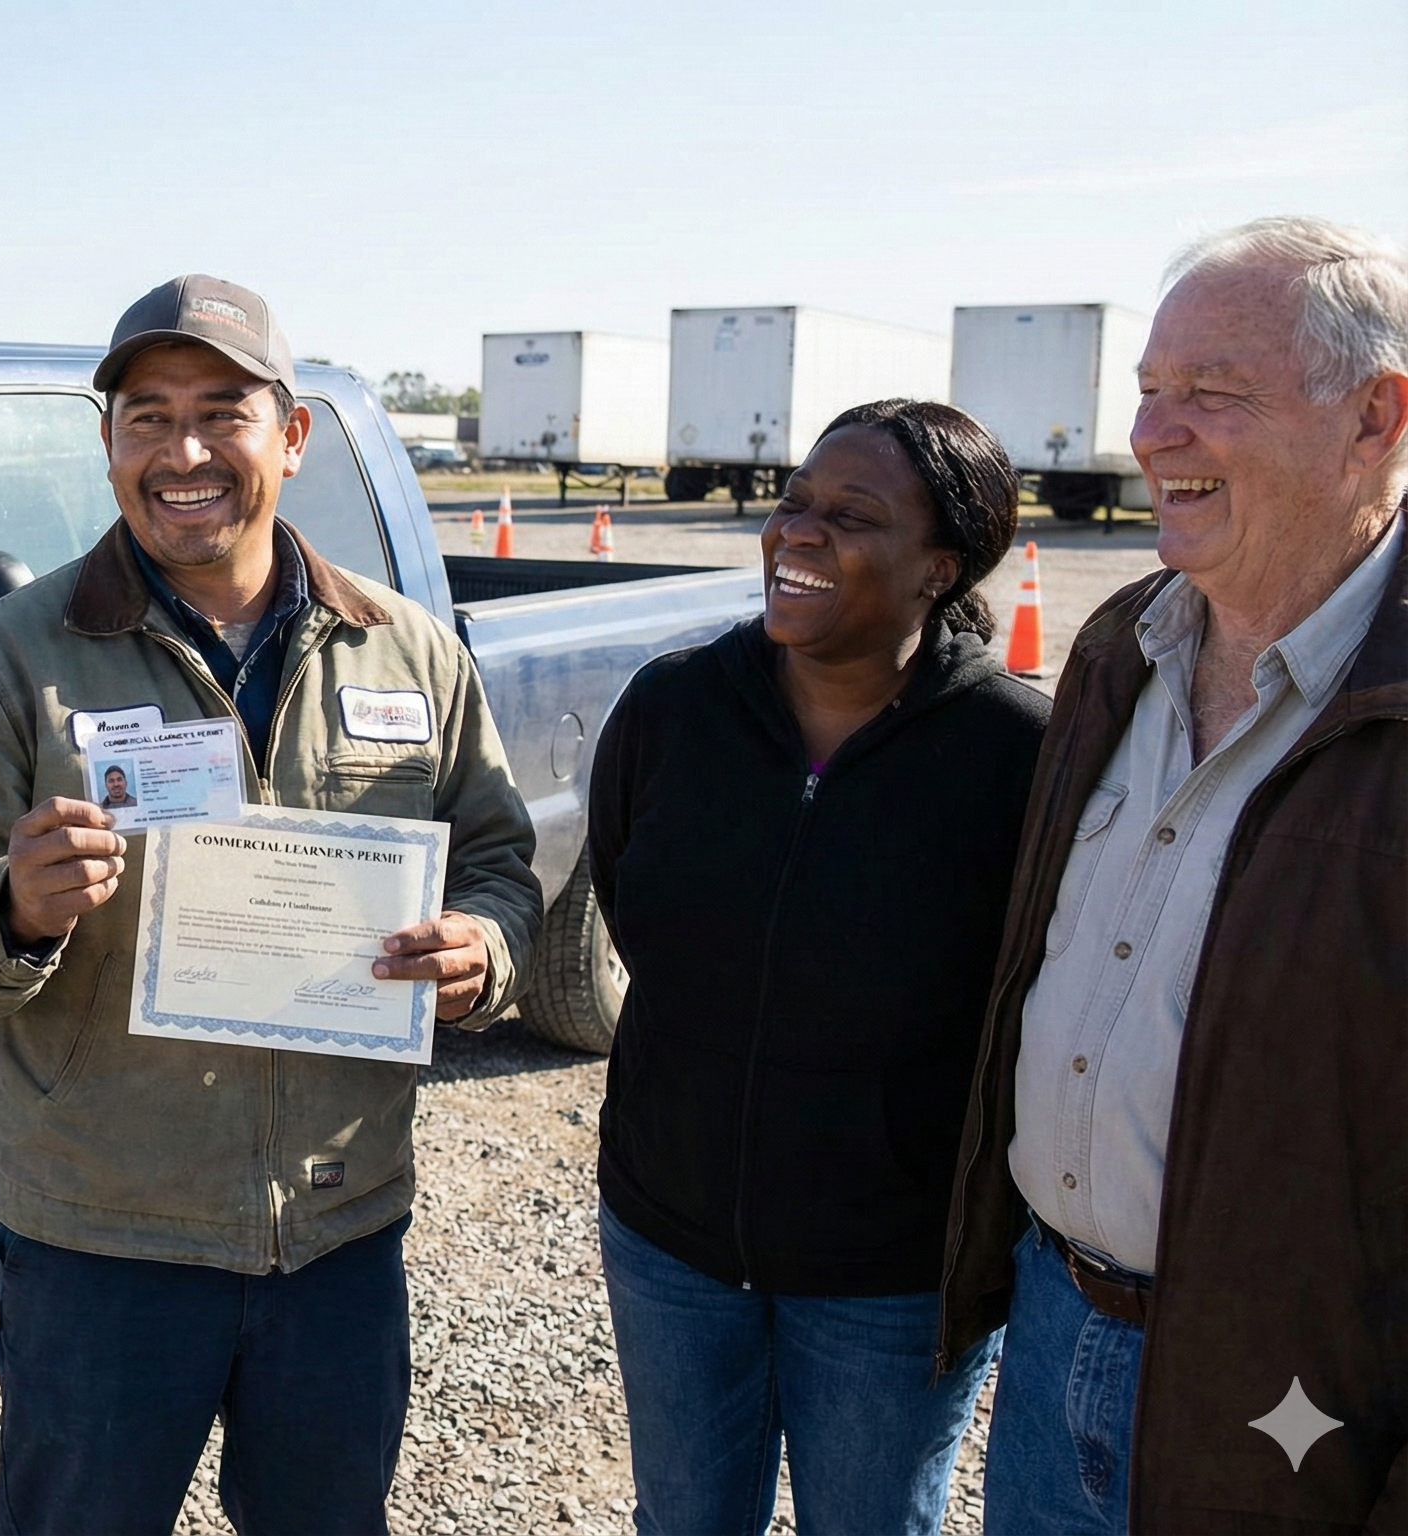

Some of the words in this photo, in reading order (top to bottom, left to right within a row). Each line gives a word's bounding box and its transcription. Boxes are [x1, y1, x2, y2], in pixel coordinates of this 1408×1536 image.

[194, 834, 282, 852] COMMERCIAL
[285, 844, 355, 860] LEARNER'S
[357, 850, 405, 864] PERMIT
